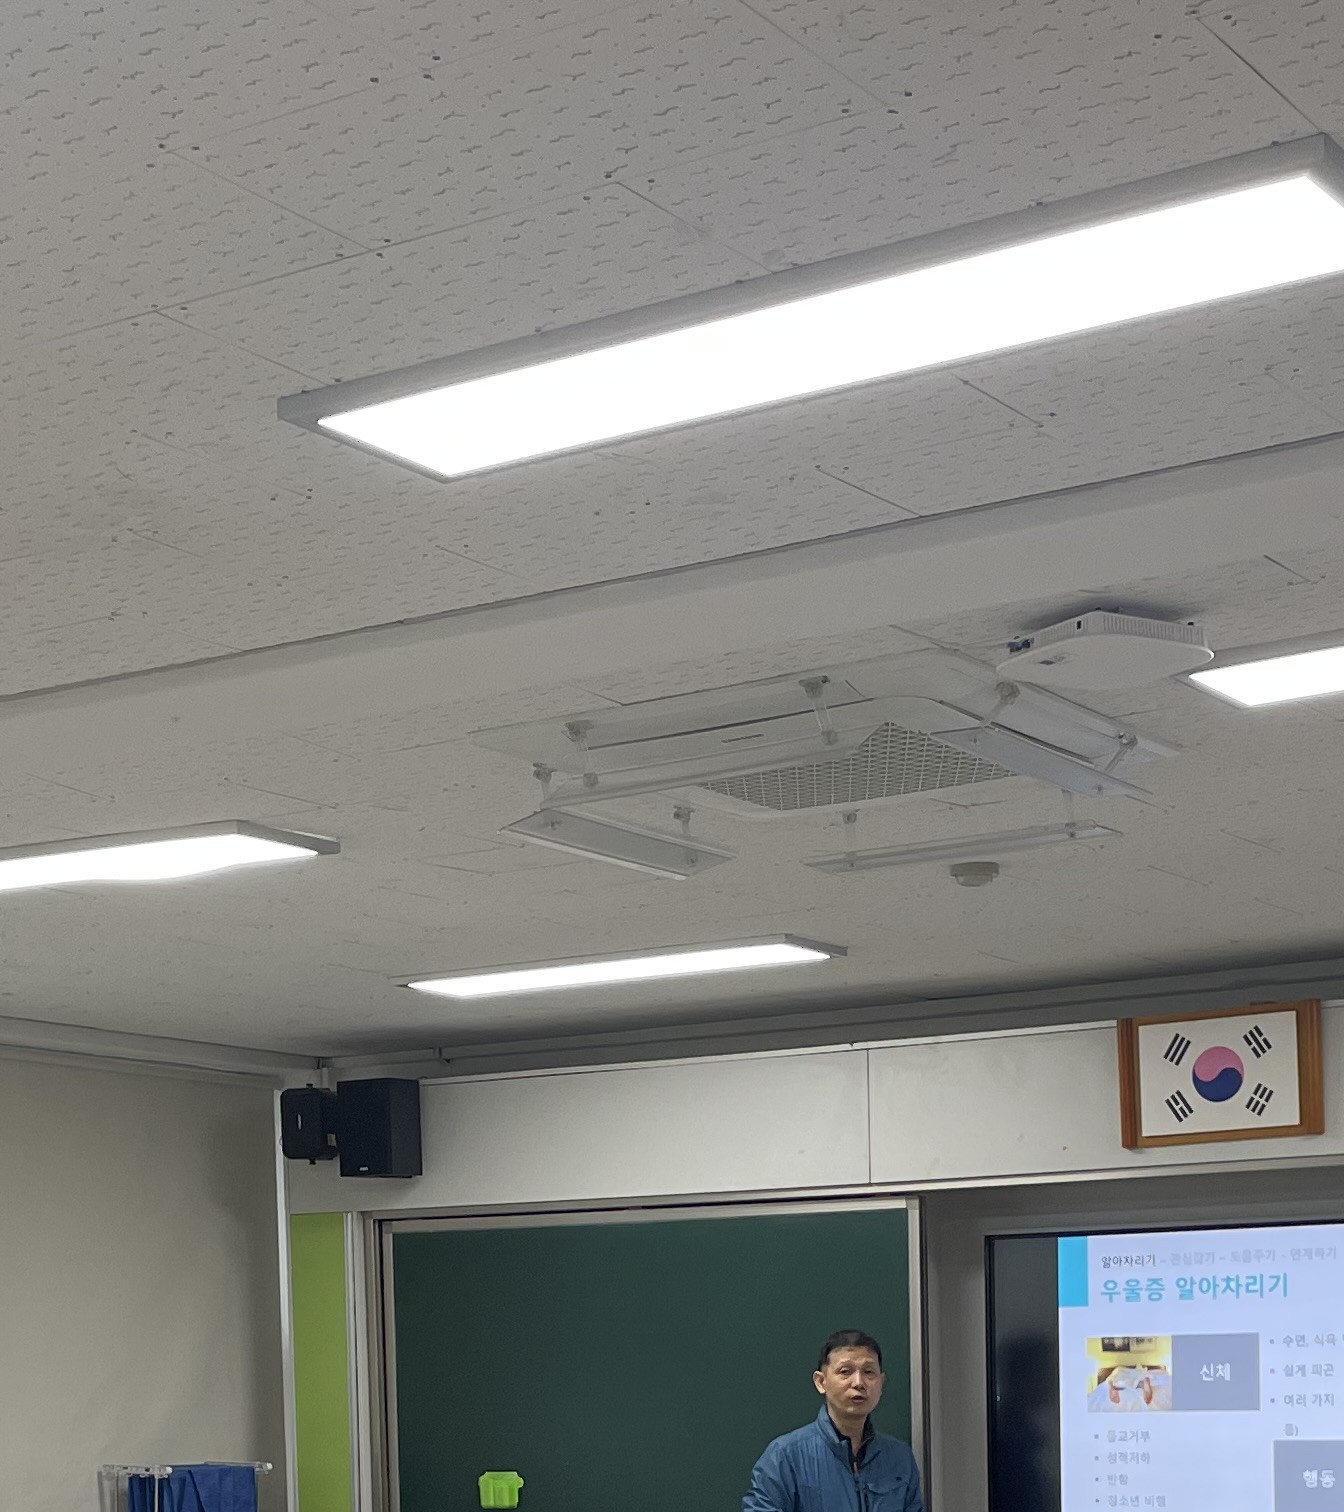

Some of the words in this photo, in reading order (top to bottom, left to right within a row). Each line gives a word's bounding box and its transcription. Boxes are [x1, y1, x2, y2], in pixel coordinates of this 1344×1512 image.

[1100, 1253, 1157, 1269] 알아차리기
[1100, 1278, 1166, 1304] 우울증
[1175, 1272, 1289, 1301] 알아차리기
[1198, 1362, 1232, 1382] 신체
[1283, 1392, 1307, 1407] 여러
[1311, 1392, 1335, 1407] 가지
[1302, 1469, 1337, 1489] 행동
